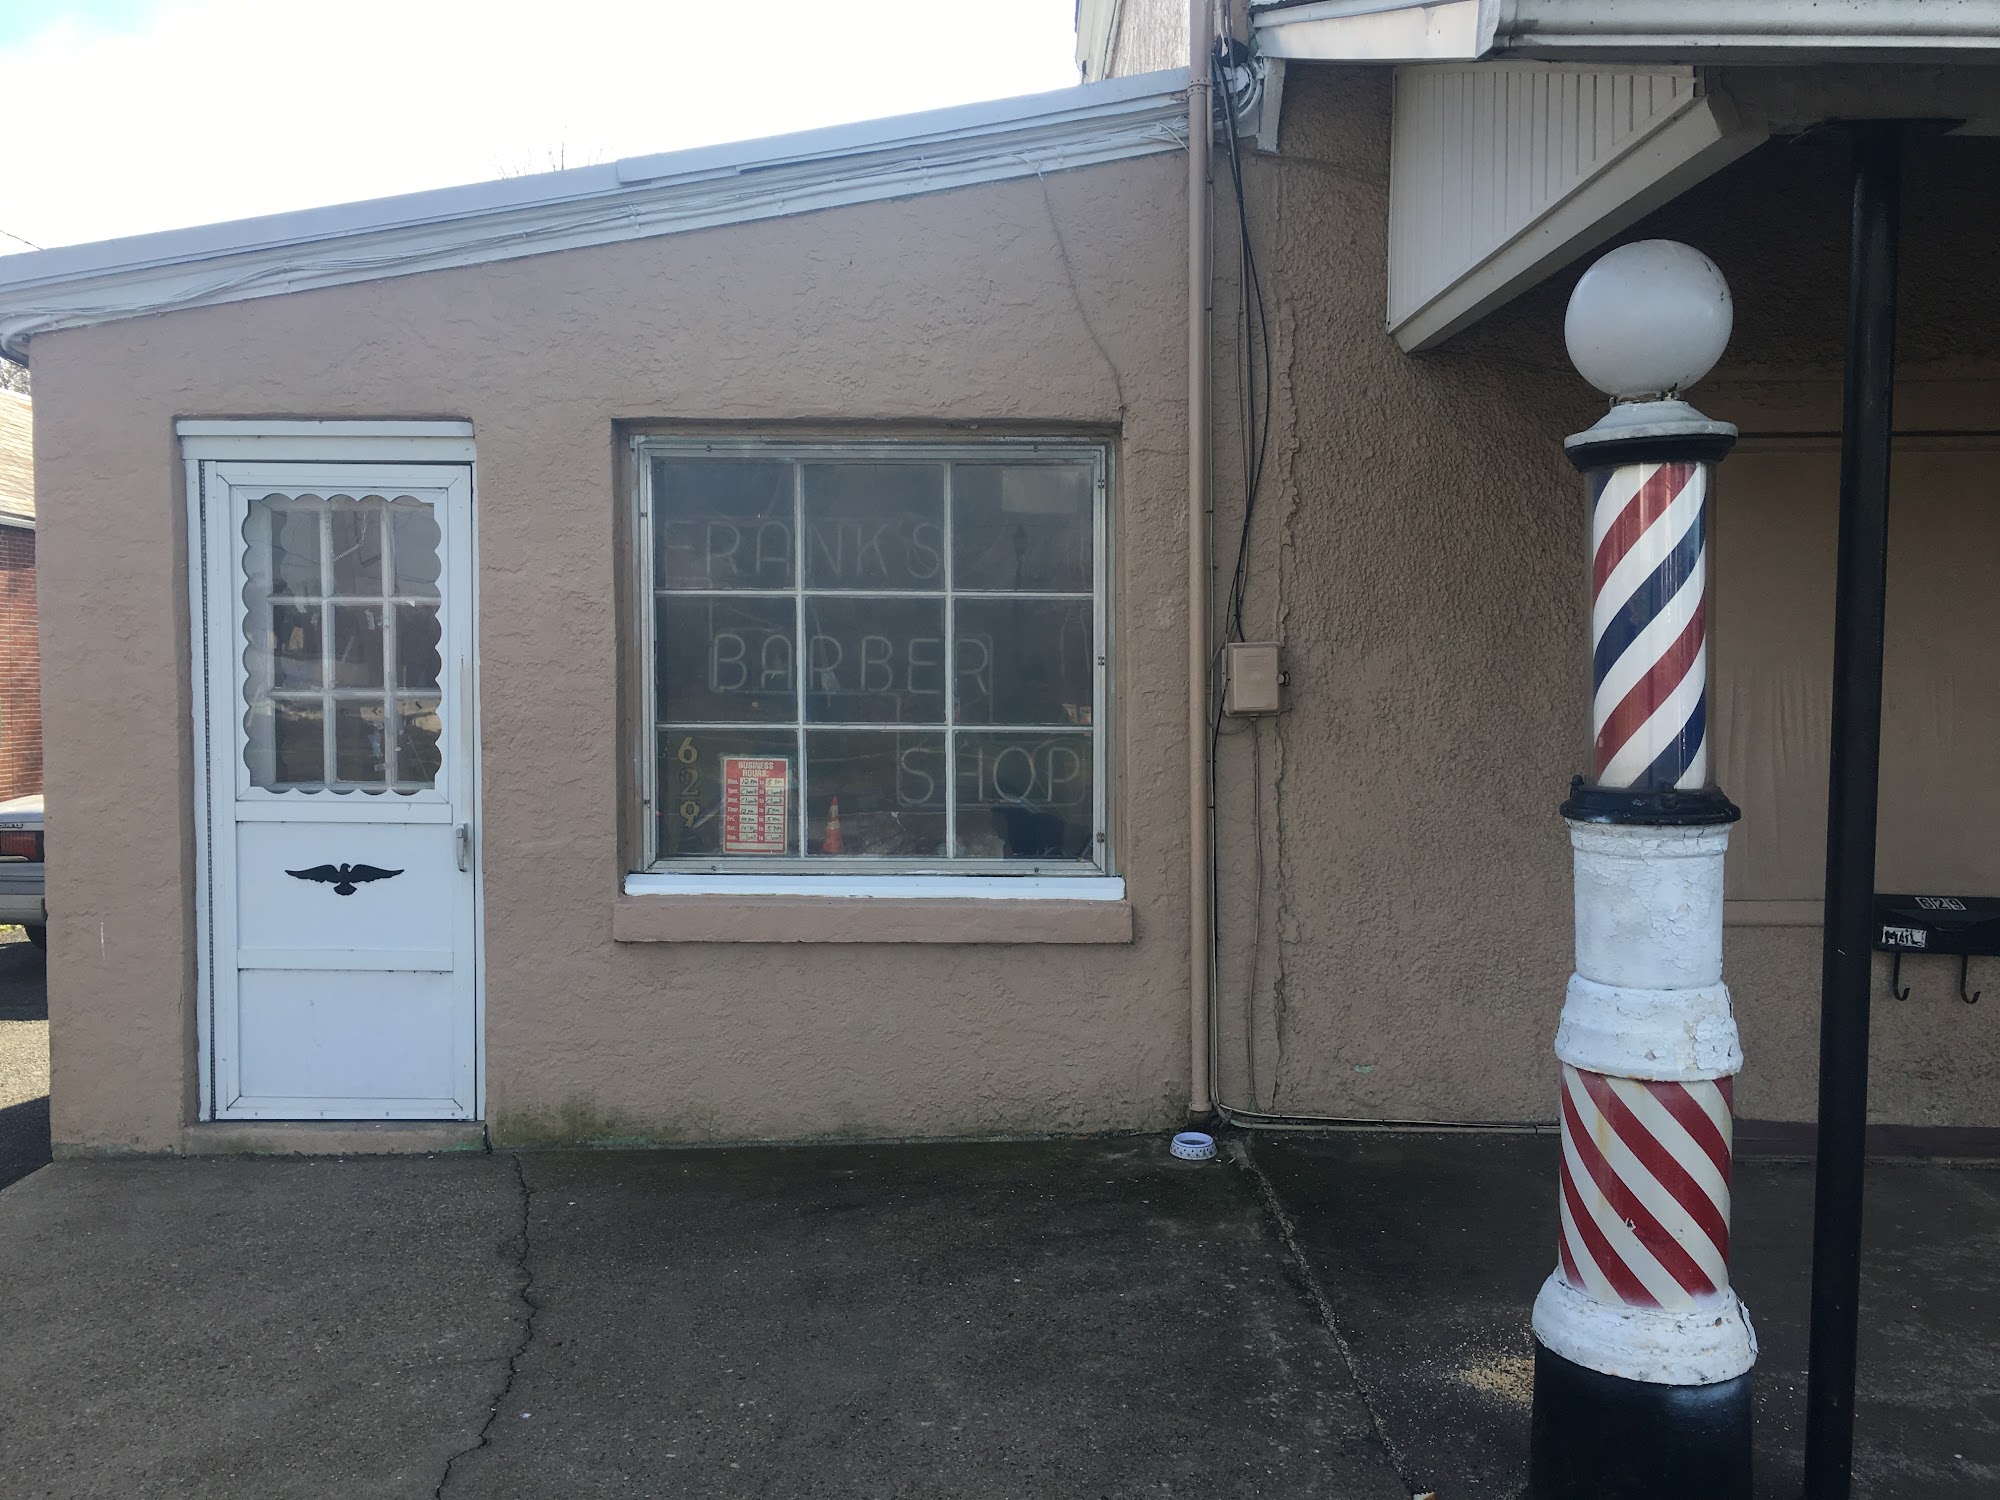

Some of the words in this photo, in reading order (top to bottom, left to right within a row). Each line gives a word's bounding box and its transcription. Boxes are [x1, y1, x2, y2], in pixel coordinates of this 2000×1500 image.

[713, 633, 988, 695] BARBER
[738, 761, 774, 769] BUSINESS
[742, 769, 769, 777] HOURS:
[900, 745, 1080, 803] SHOP
